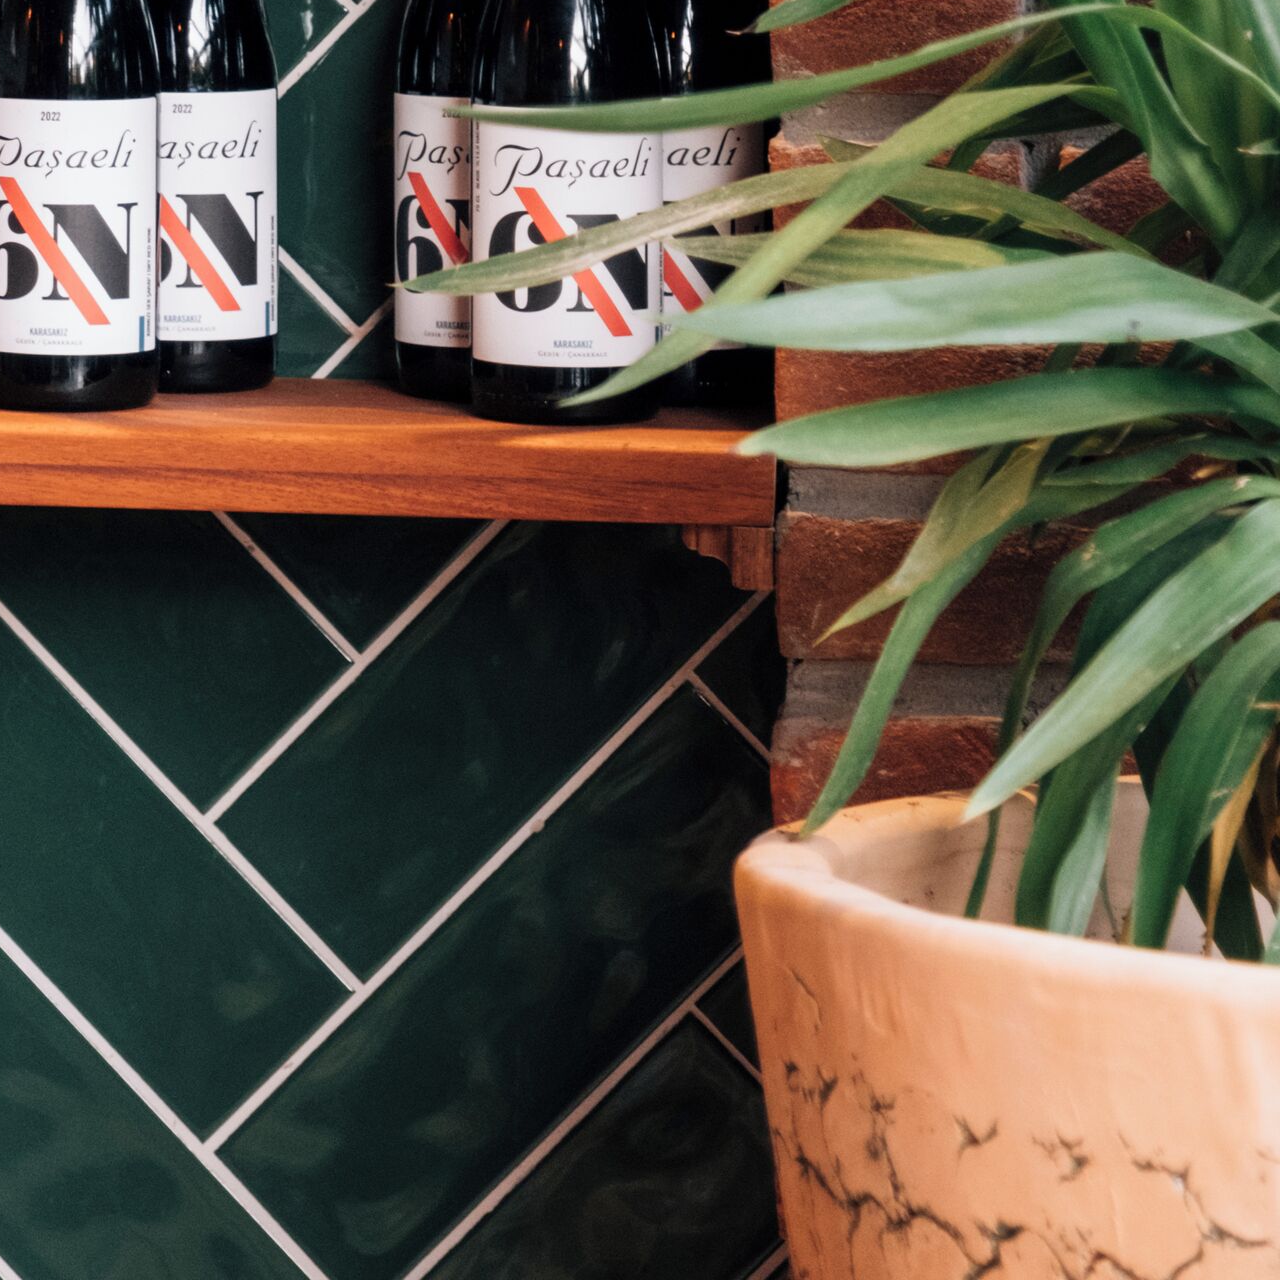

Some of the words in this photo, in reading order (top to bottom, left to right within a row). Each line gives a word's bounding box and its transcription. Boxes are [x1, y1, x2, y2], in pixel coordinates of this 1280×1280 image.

[172, 103, 193, 114] 2022
[40, 111, 61, 122] 2022
[489, 137, 653, 197] Paşaeli
[553, 339, 593, 349] KARASAKIZ
